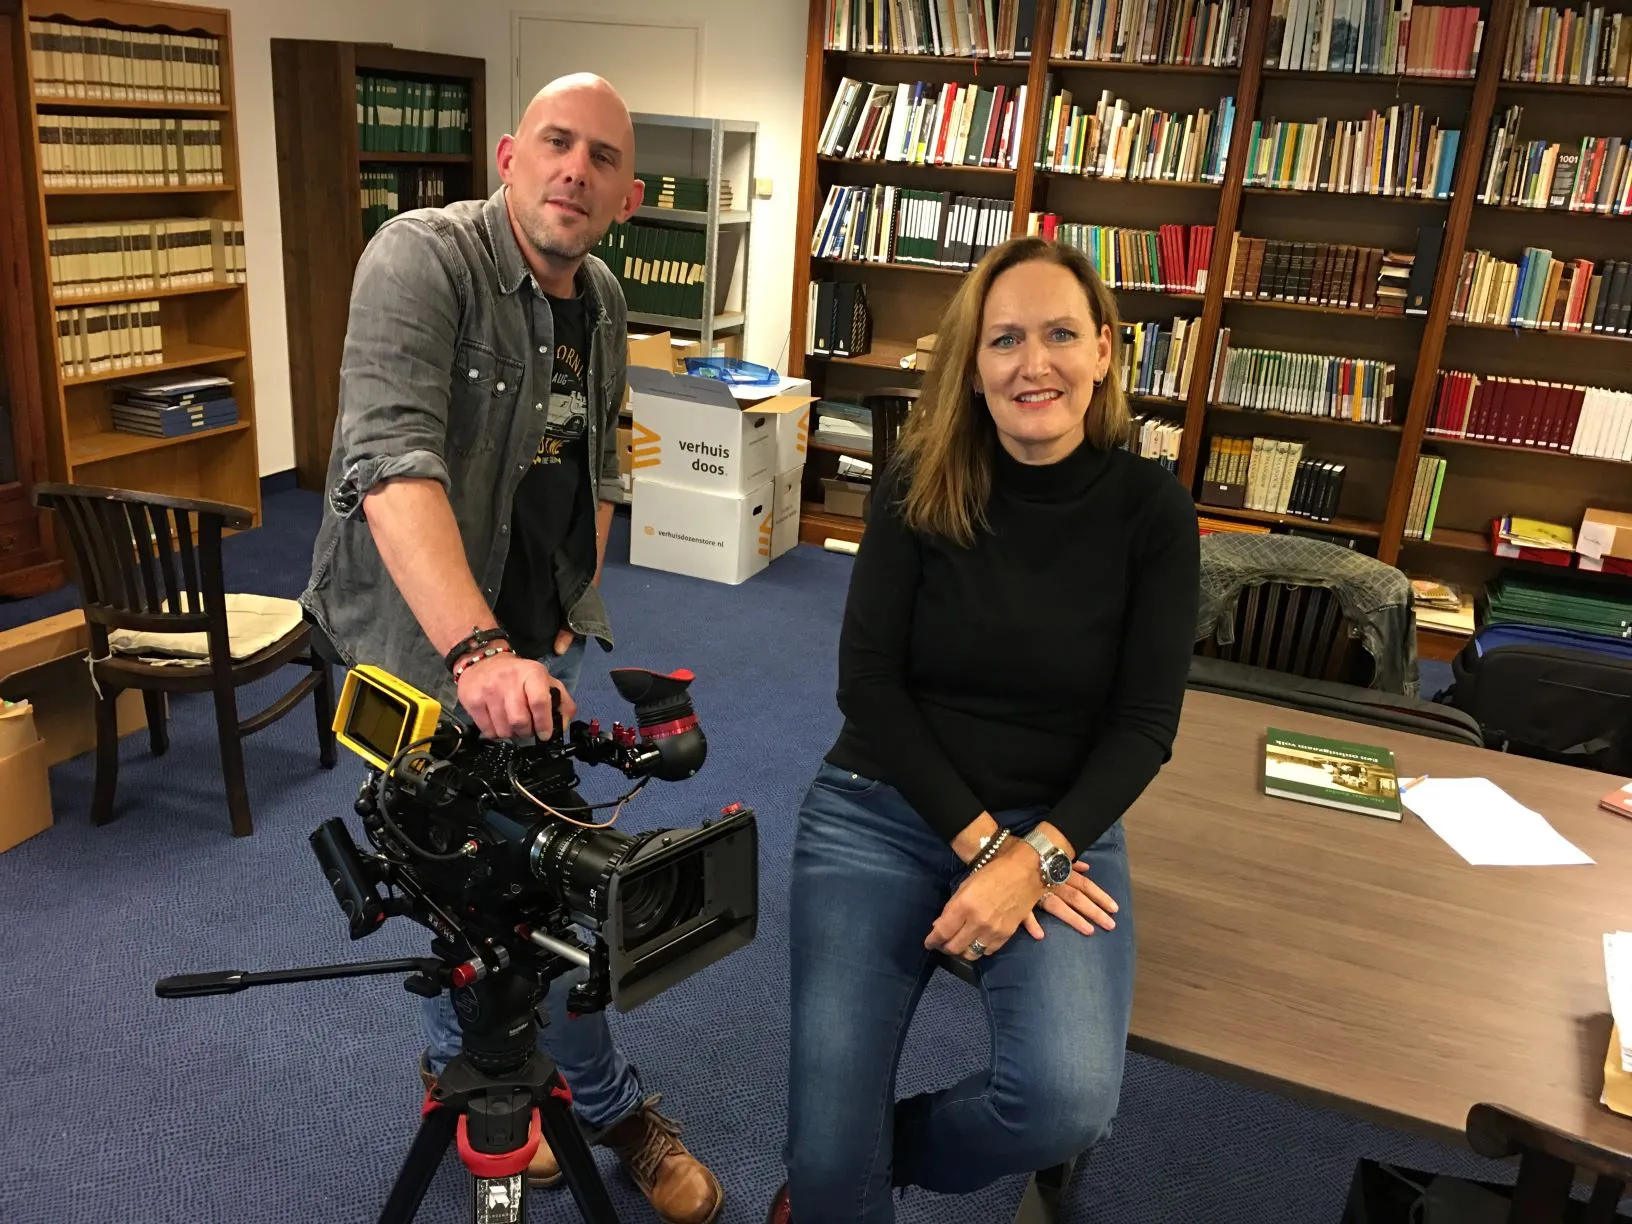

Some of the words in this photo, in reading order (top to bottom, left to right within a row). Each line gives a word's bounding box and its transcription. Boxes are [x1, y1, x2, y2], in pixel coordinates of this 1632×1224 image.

[1560, 155, 1578, 164] 1001
[678, 440, 730, 459] verhuis
[692, 458, 725, 476] doos
[658, 530, 724, 548] verhuisdozenstore.nl
